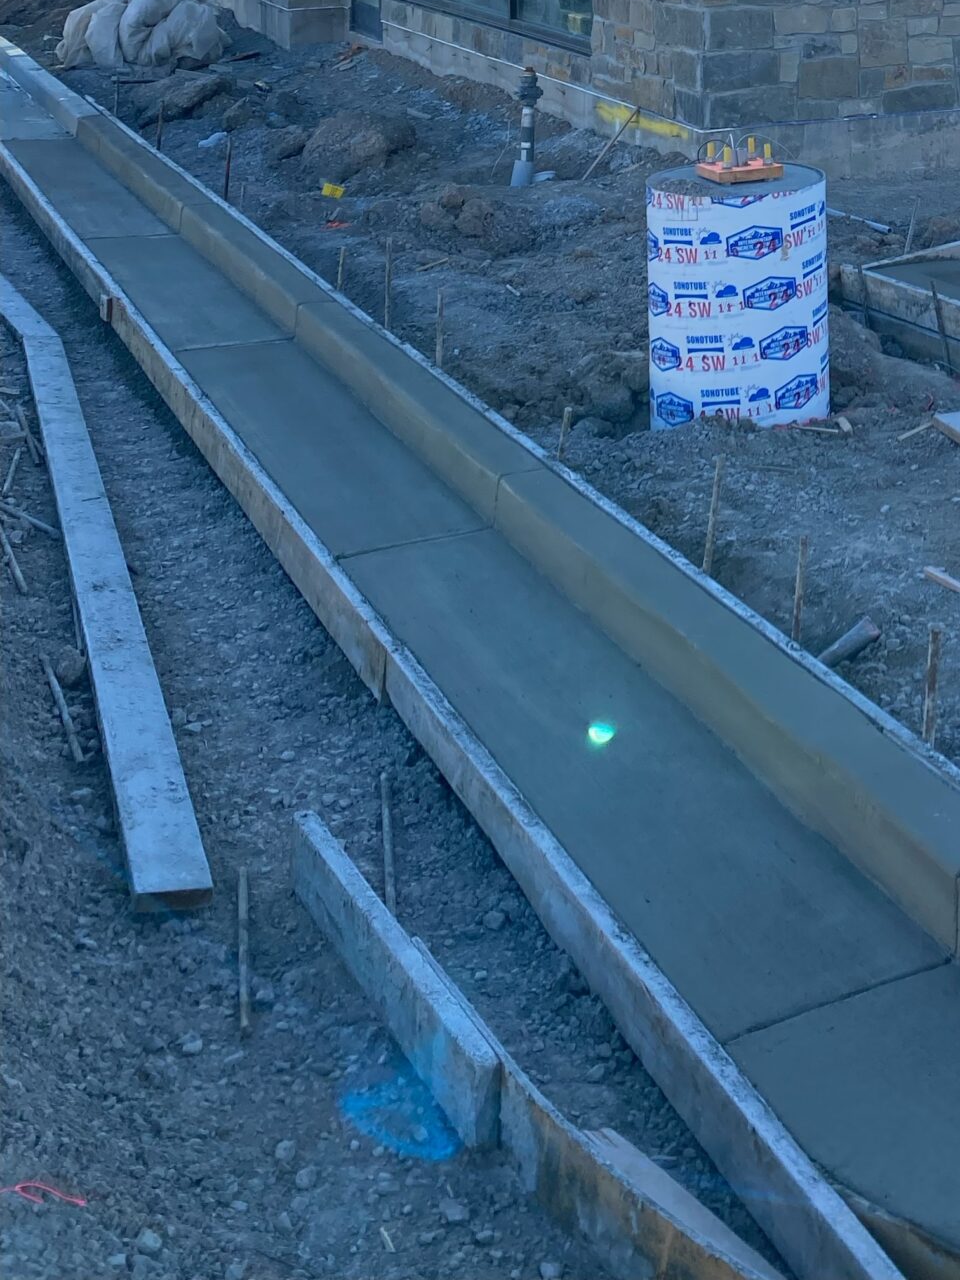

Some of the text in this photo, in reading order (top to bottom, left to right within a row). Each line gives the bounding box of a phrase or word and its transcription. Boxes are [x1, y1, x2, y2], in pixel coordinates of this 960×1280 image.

[667, 192, 685, 211] SW
[658, 247, 672, 263] 24
[676, 247, 698, 264] SW
[784, 229, 804, 250] SW
[674, 281, 708, 290] SONOTUBE
[666, 302, 682, 318] 24
[688, 302, 711, 318] SW
[796, 278, 813, 299] SW
[686, 335, 724, 344] SONOTUBE
[702, 355, 725, 372] SW
[700, 387, 740, 398] SONOTUBE
